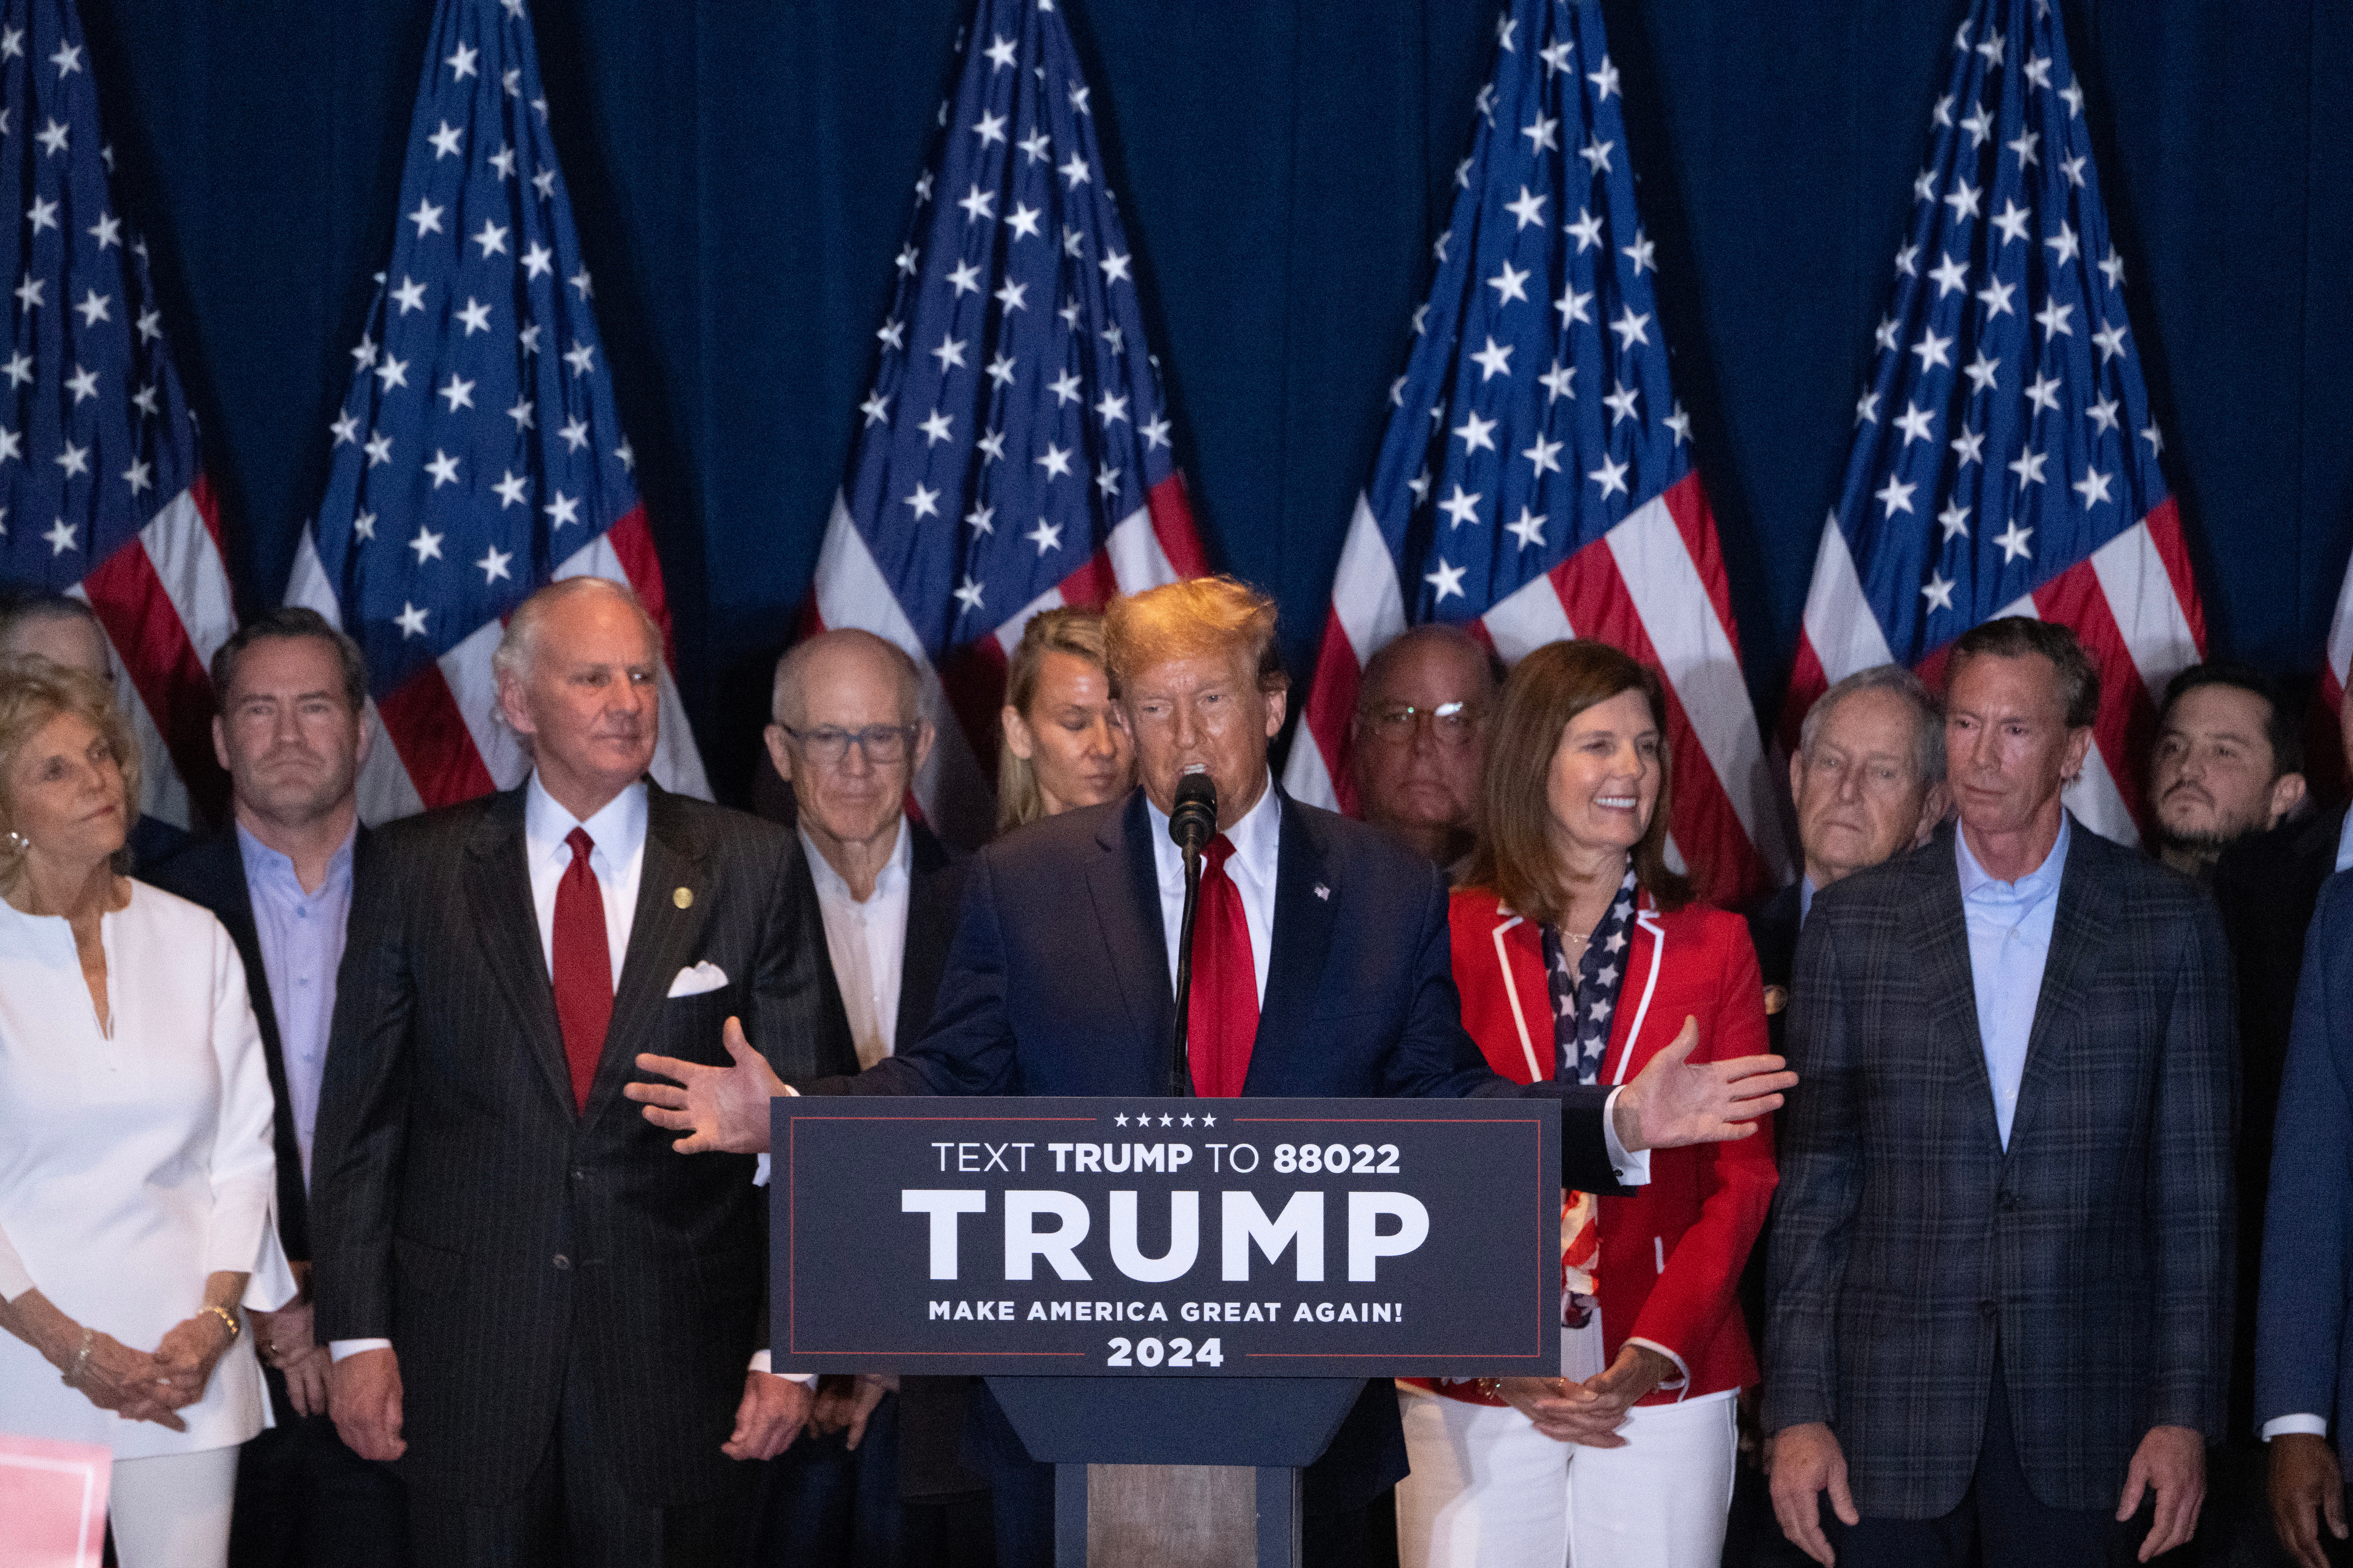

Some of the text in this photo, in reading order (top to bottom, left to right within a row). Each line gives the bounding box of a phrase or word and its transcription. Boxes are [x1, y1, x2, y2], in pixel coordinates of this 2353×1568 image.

[931, 1142, 1400, 1174] TEXT TRUMP TO 88022
[901, 1189, 1429, 1283] TRUMP
[929, 1300, 1402, 1323] MAKE AMERICA GREAT AGAIN!
[1107, 1337, 1224, 1367] 2024
